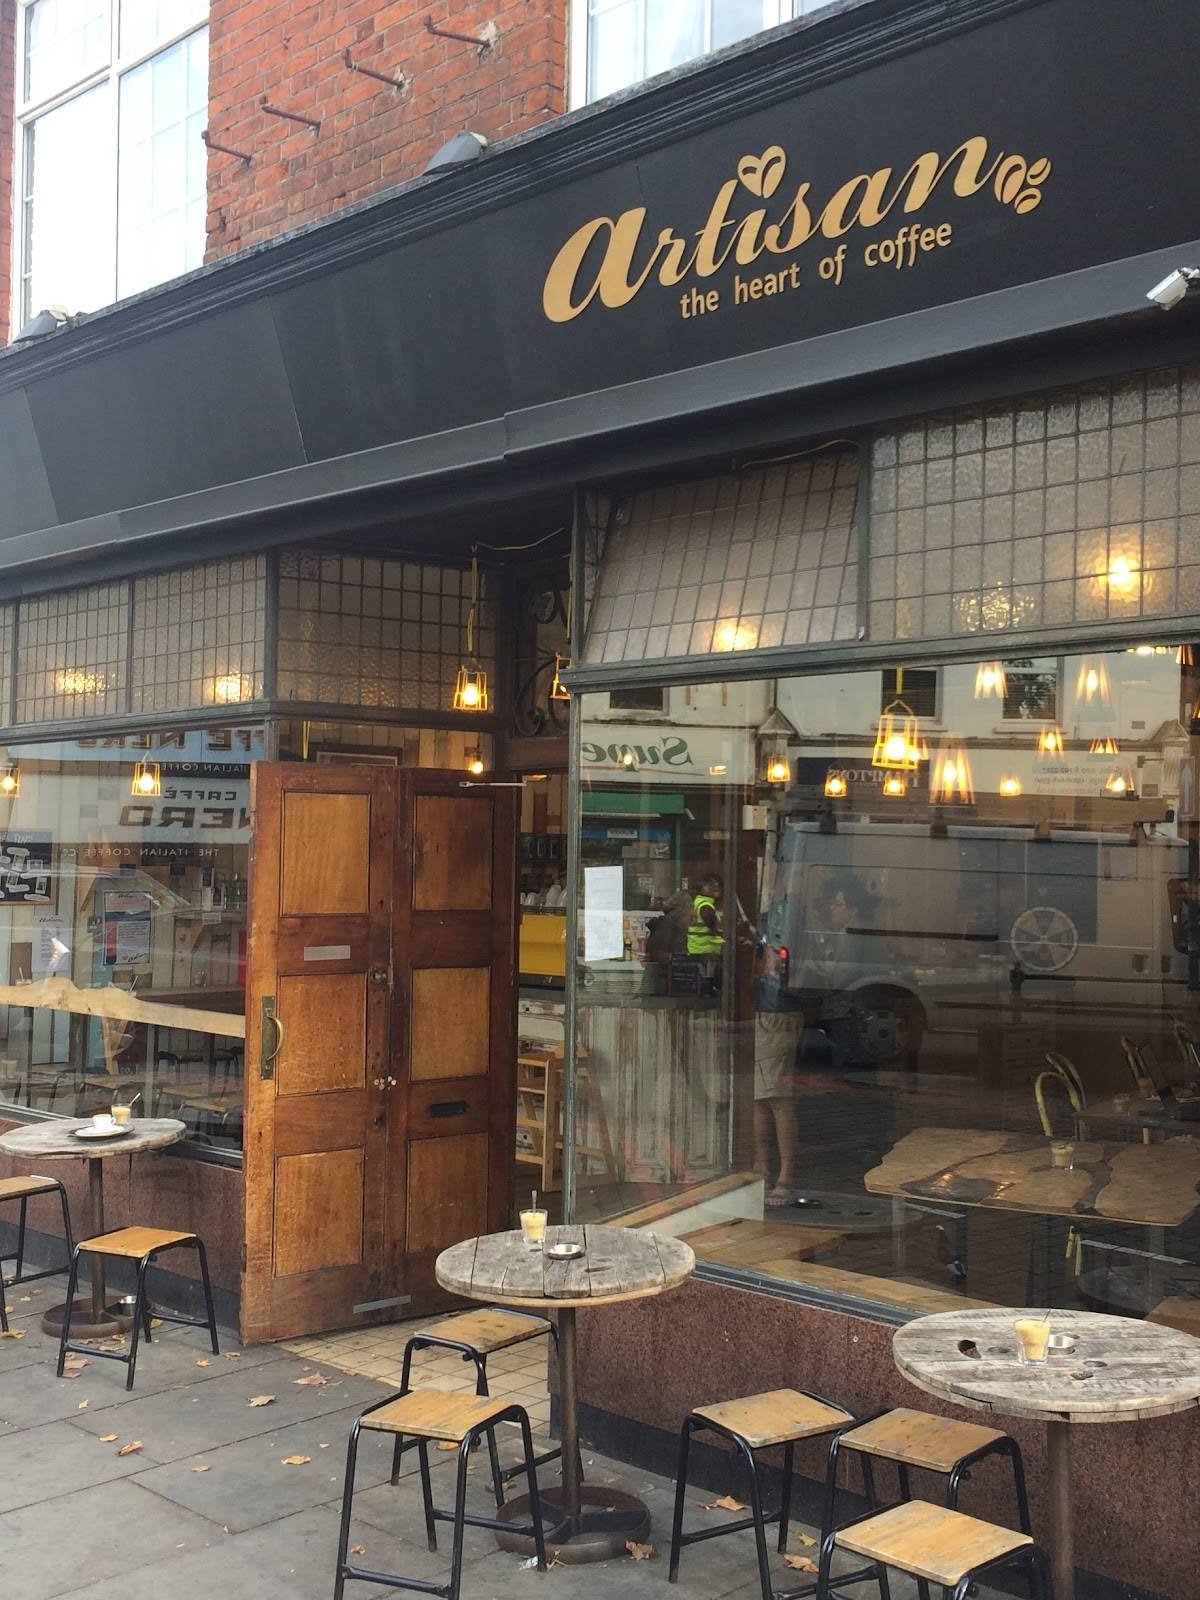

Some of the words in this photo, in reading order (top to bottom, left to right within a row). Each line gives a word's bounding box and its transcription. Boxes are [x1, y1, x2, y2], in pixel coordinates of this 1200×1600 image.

[680, 289, 719, 319] the
[734, 264, 800, 305] heart
[818, 244, 847, 285] of
[864, 222, 952, 271] coffee
